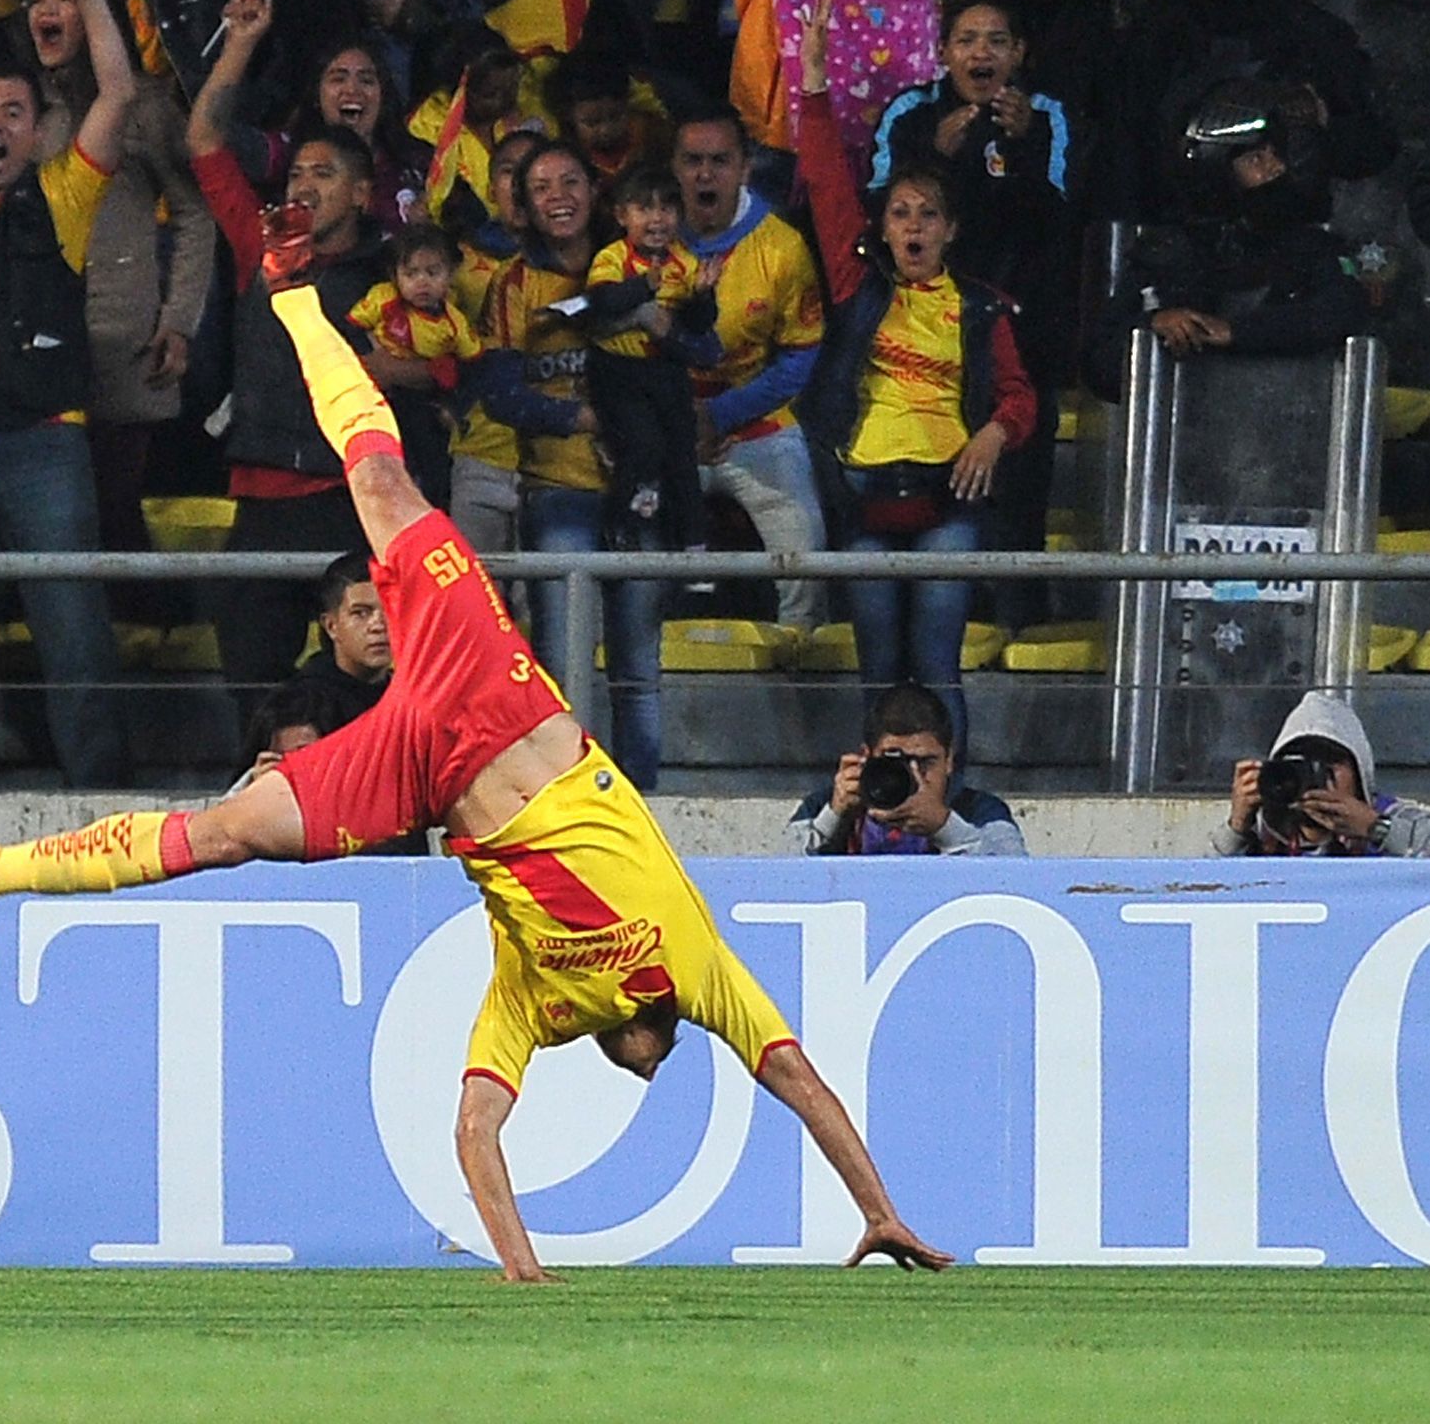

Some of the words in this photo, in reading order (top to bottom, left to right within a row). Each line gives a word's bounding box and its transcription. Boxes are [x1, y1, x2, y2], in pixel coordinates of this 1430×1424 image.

[422, 540, 470, 590] 15
[30, 817, 113, 864] Totalplay
[538, 925, 664, 974] Caliente
